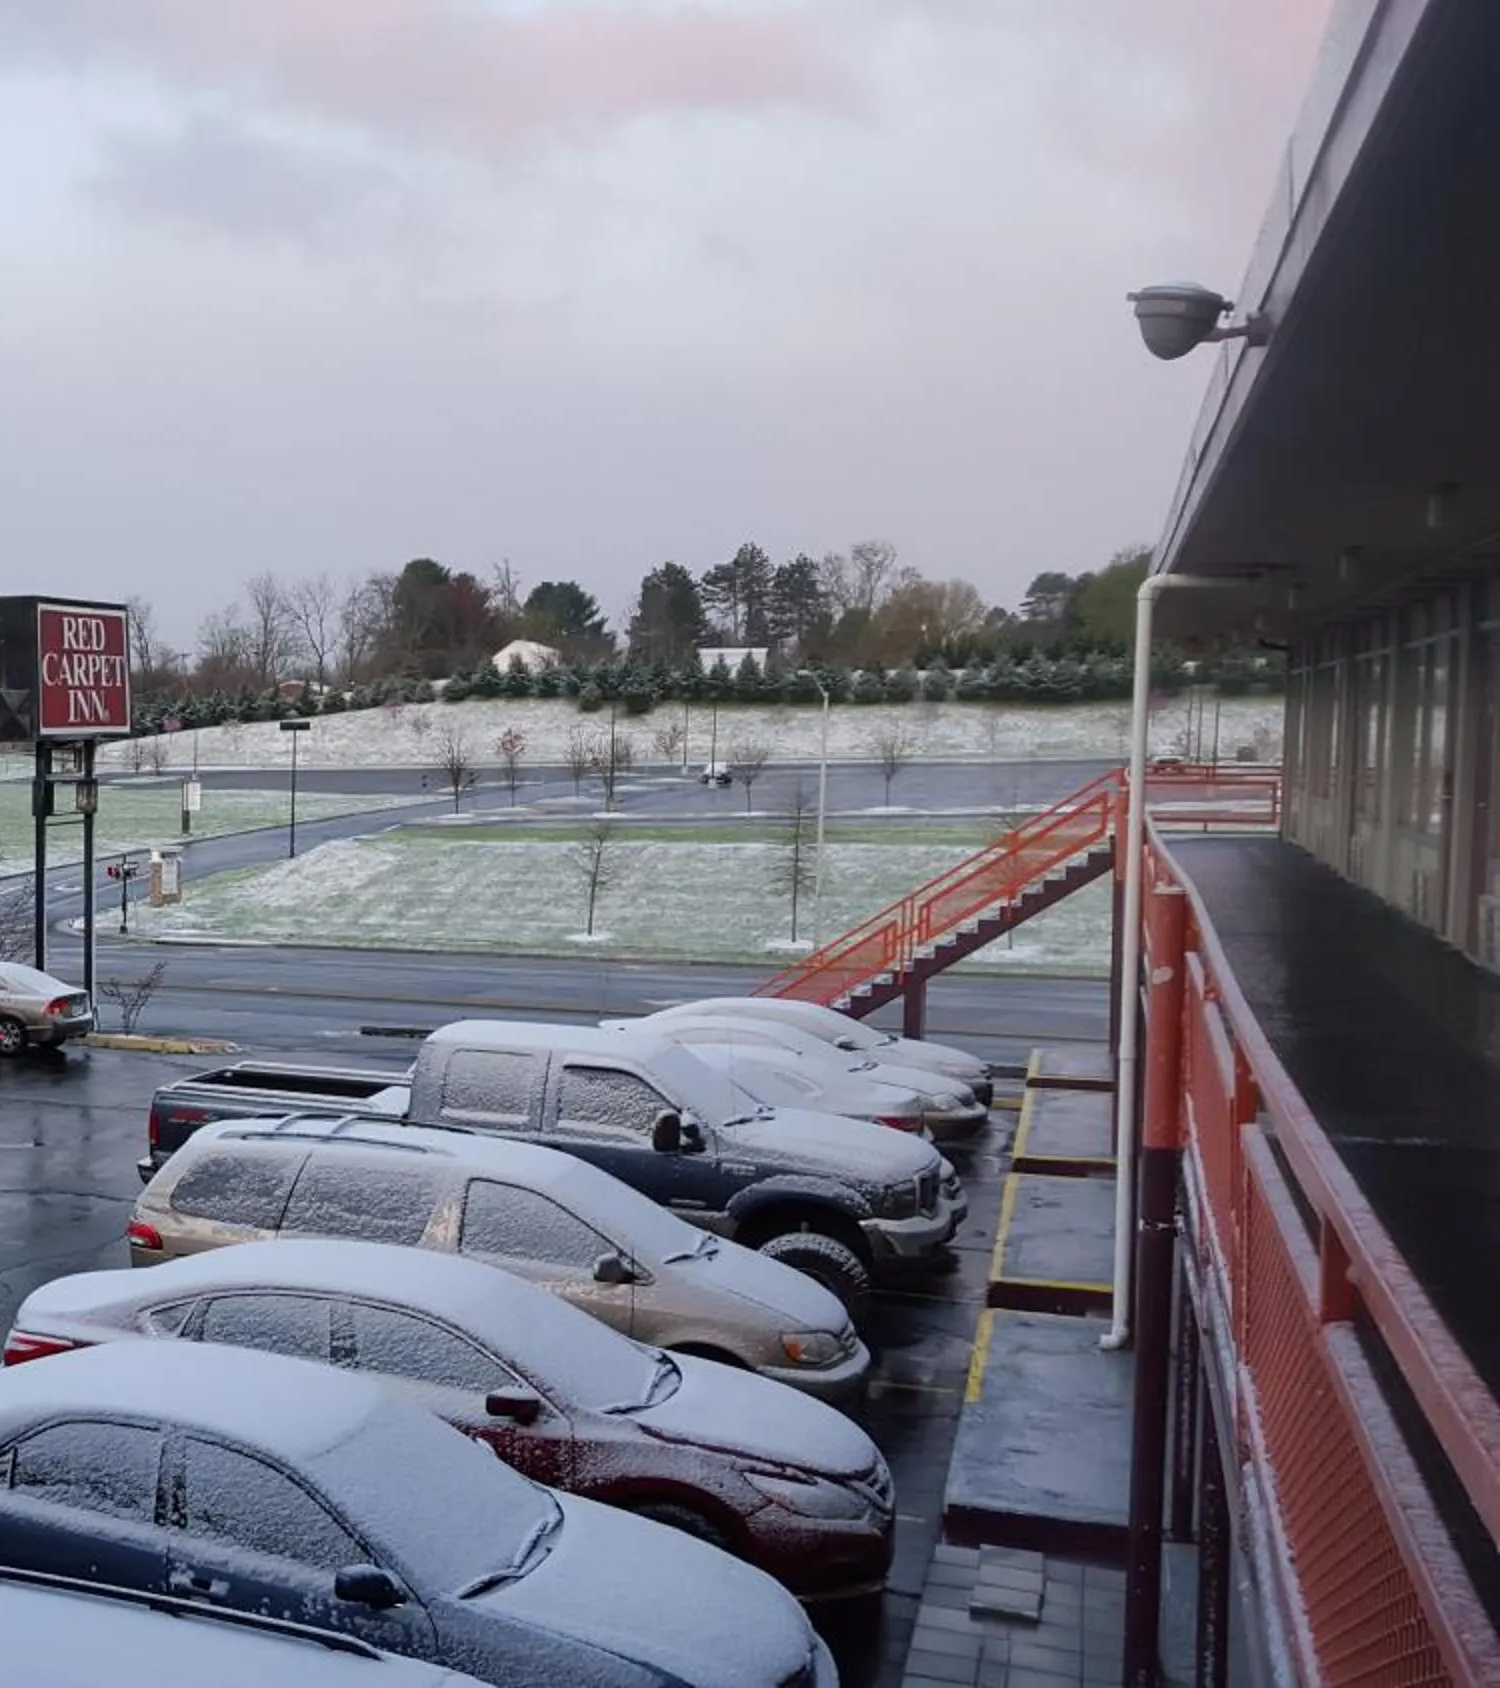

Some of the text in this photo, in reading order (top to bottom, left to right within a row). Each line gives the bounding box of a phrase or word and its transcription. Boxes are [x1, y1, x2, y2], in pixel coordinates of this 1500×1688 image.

[62, 616, 106, 651] RED
[43, 651, 124, 687] CARPET
[67, 689, 105, 722] INN
